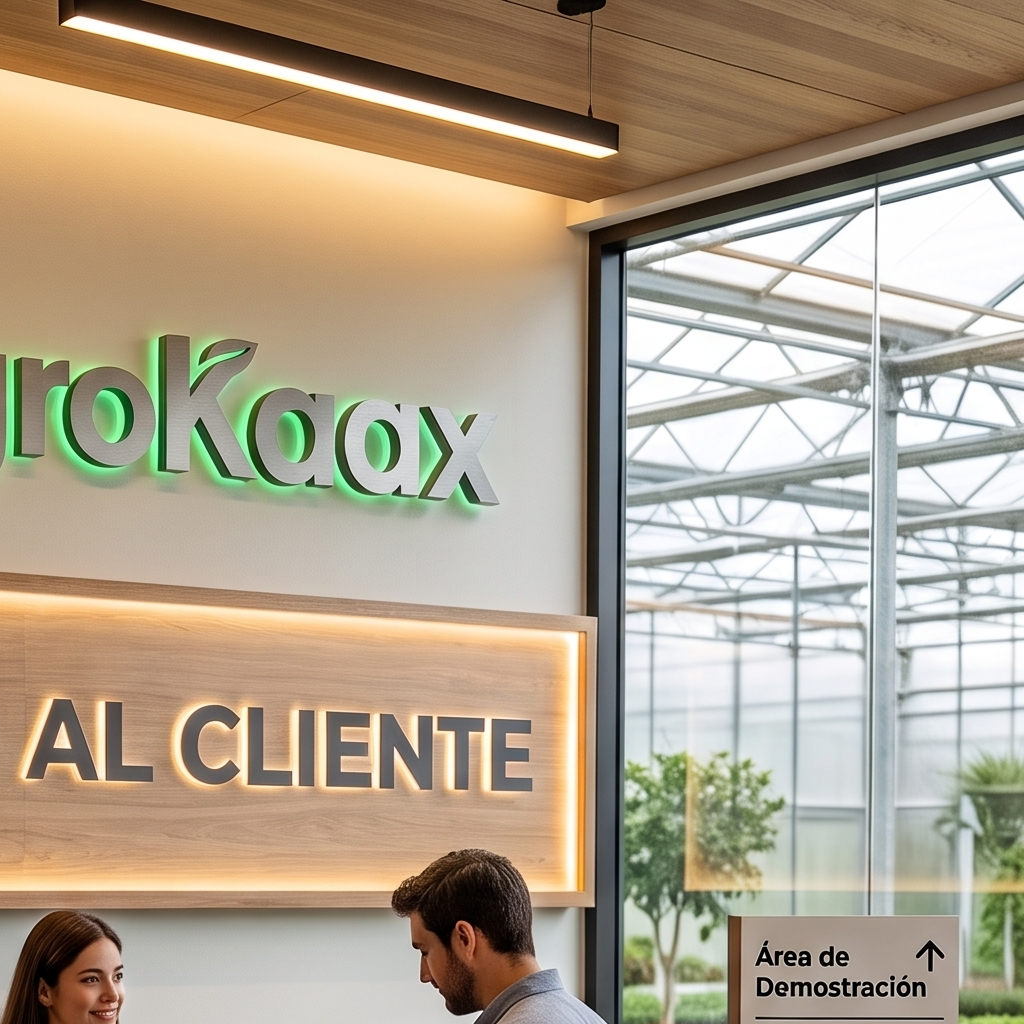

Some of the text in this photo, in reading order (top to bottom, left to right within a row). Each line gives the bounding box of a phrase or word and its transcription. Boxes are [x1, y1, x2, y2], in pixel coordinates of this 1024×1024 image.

[25, 698, 154, 783] AL
[180, 704, 533, 792] CLIENTE
[755, 940, 850, 967] Área de
[756, 975, 927, 998] Demostración
